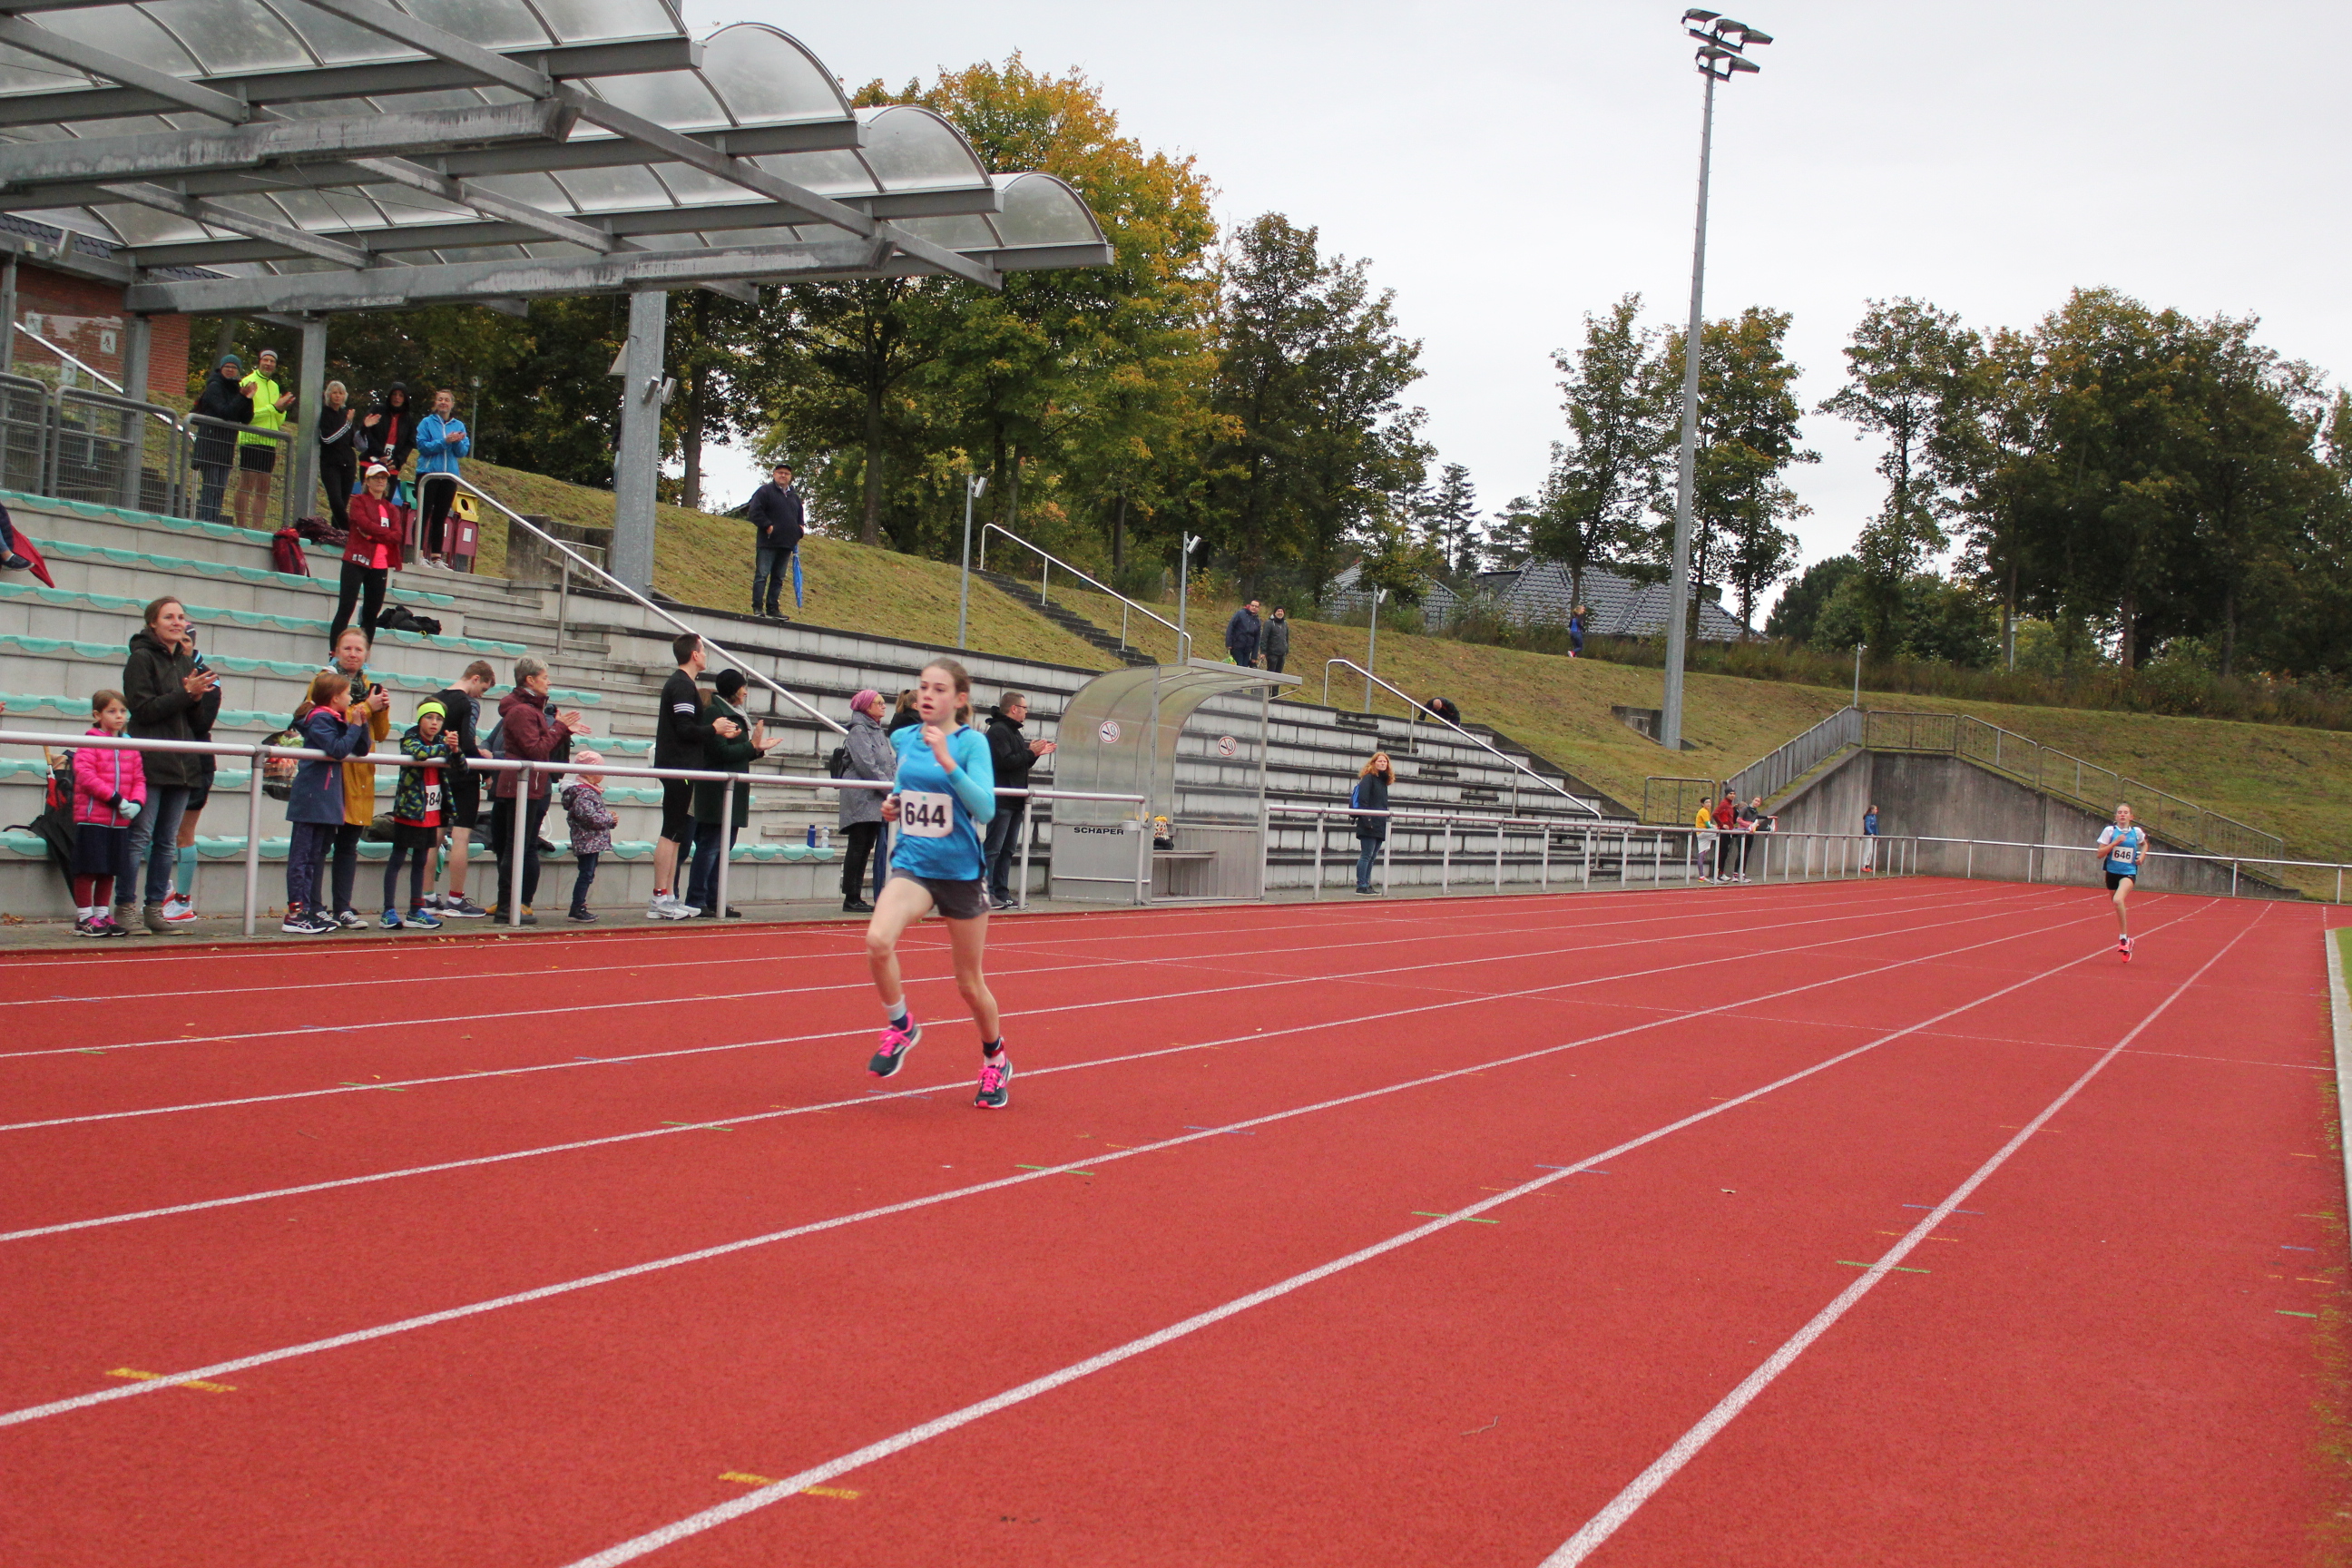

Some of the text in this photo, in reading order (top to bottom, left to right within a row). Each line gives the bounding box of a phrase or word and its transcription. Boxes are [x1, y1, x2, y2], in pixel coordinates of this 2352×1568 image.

[906, 802, 946, 828] 644
[1073, 827, 1124, 835] SCHÄPER
[2113, 849, 2131, 859] 646
